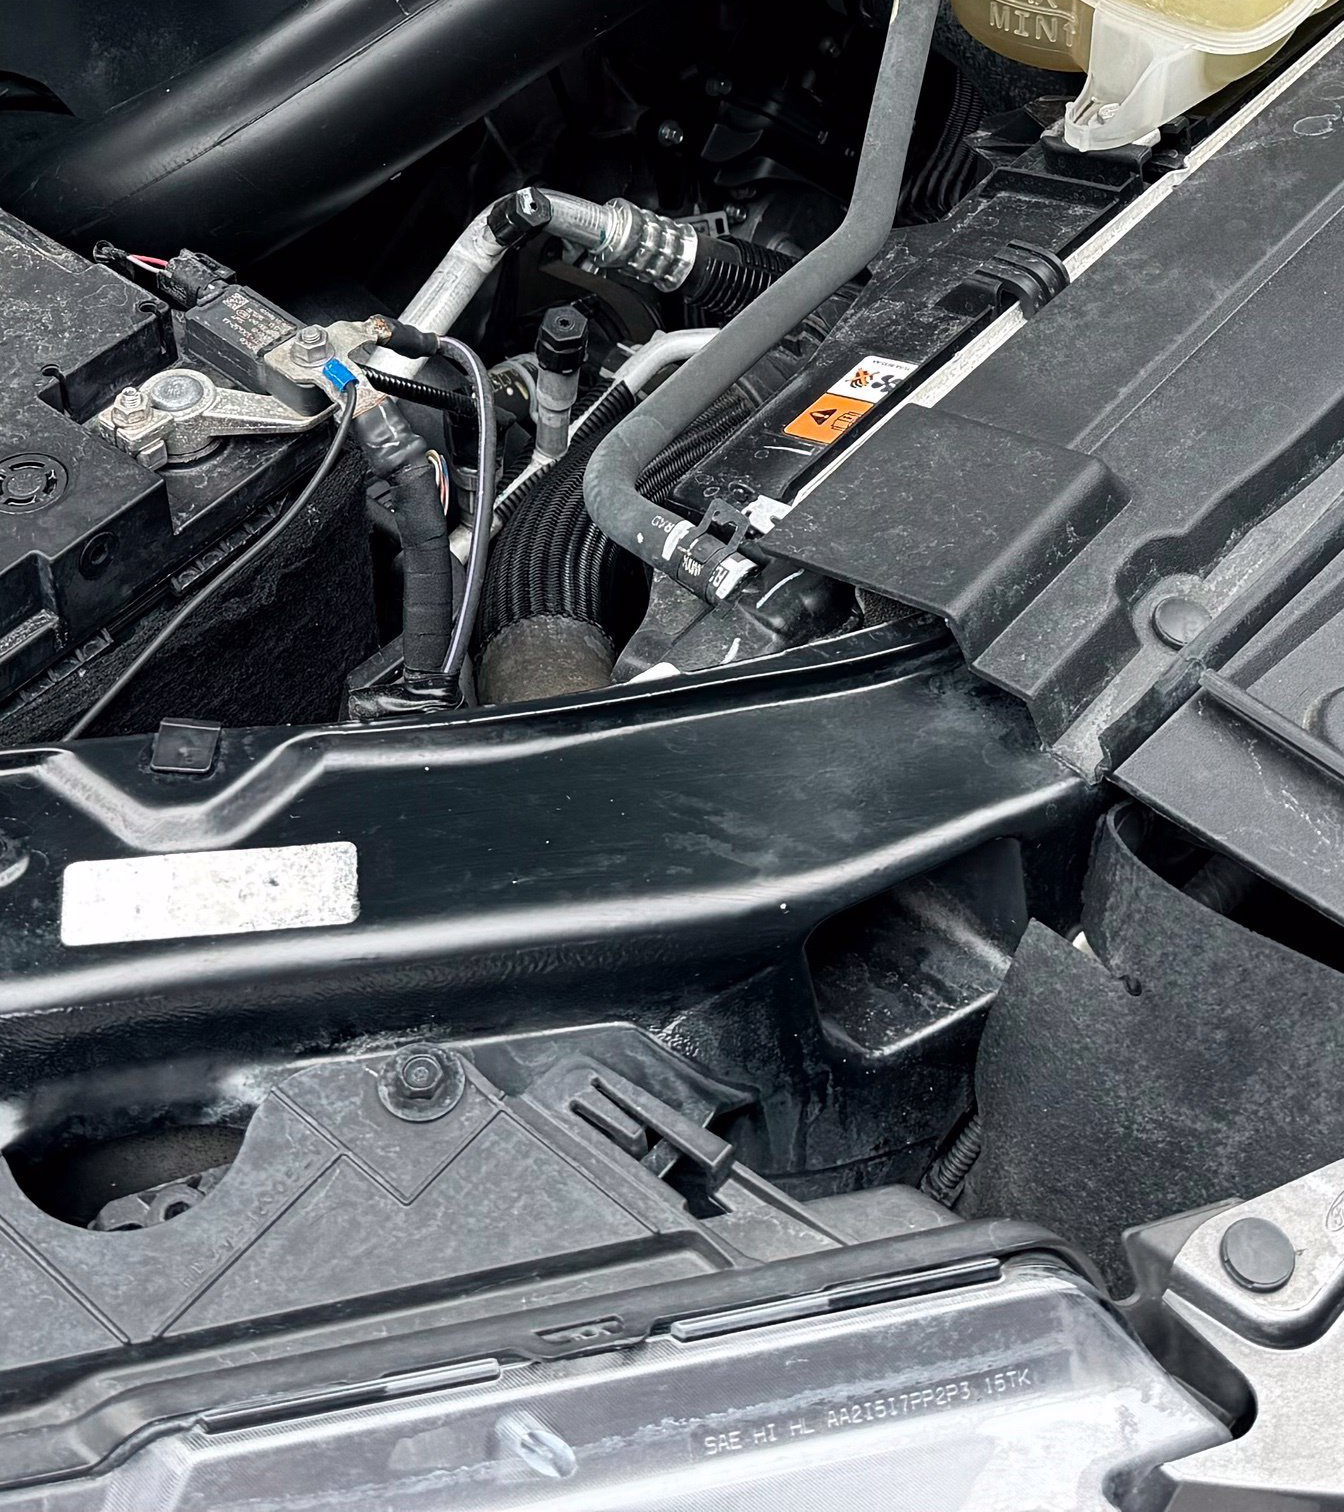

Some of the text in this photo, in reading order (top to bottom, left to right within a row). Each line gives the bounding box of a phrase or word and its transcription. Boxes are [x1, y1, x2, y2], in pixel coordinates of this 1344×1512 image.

[990, 1, 1057, 43] MIN
[651, 515, 675, 533] RAD
[705, 1431, 742, 1456] SAE
[789, 1416, 815, 1438] HL
